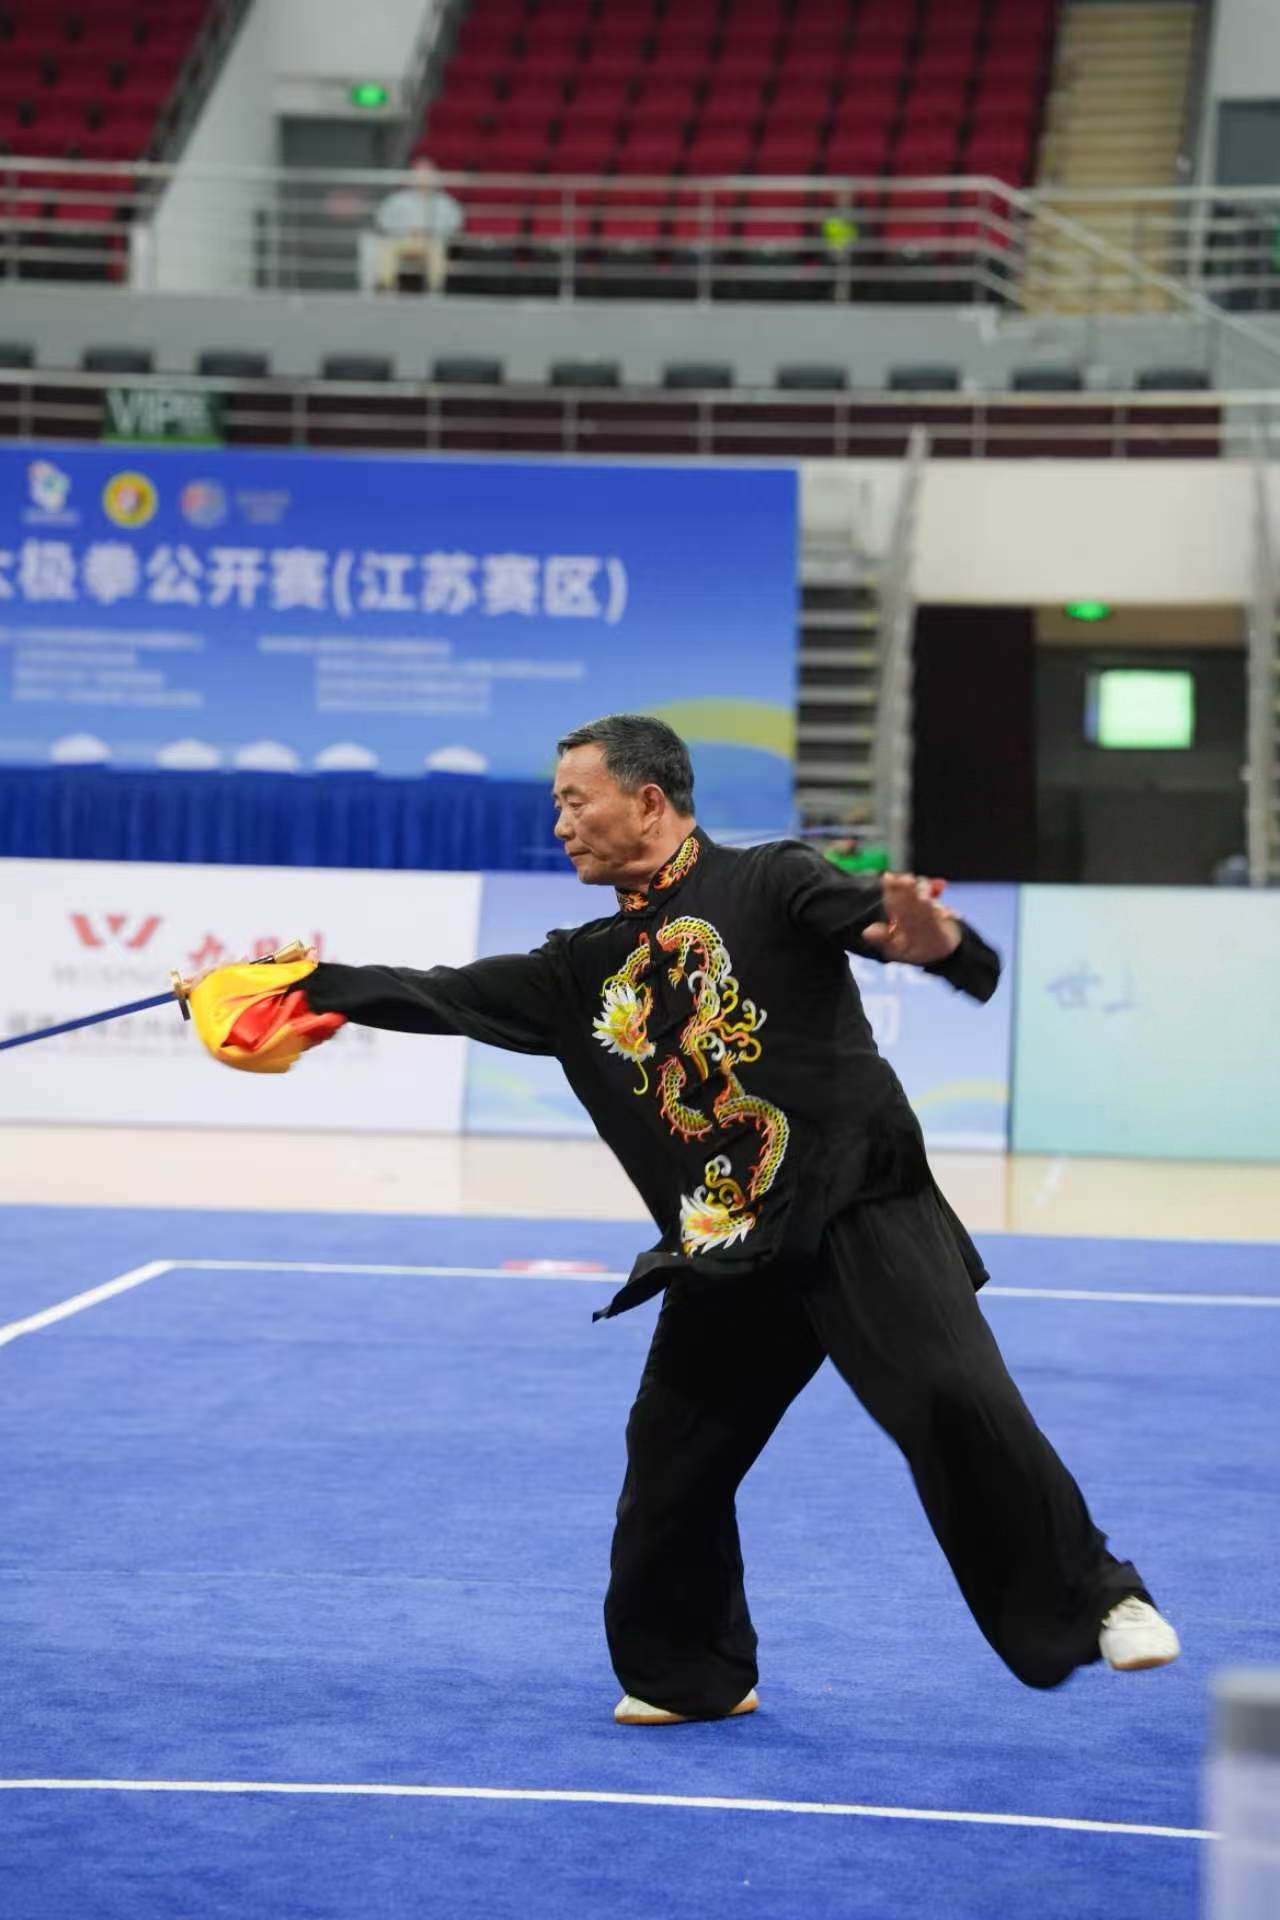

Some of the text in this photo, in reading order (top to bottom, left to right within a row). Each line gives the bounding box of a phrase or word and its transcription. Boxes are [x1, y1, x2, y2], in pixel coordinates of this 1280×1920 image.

[0, 537, 627, 624] 极拳公开赛(江苏赛区)
